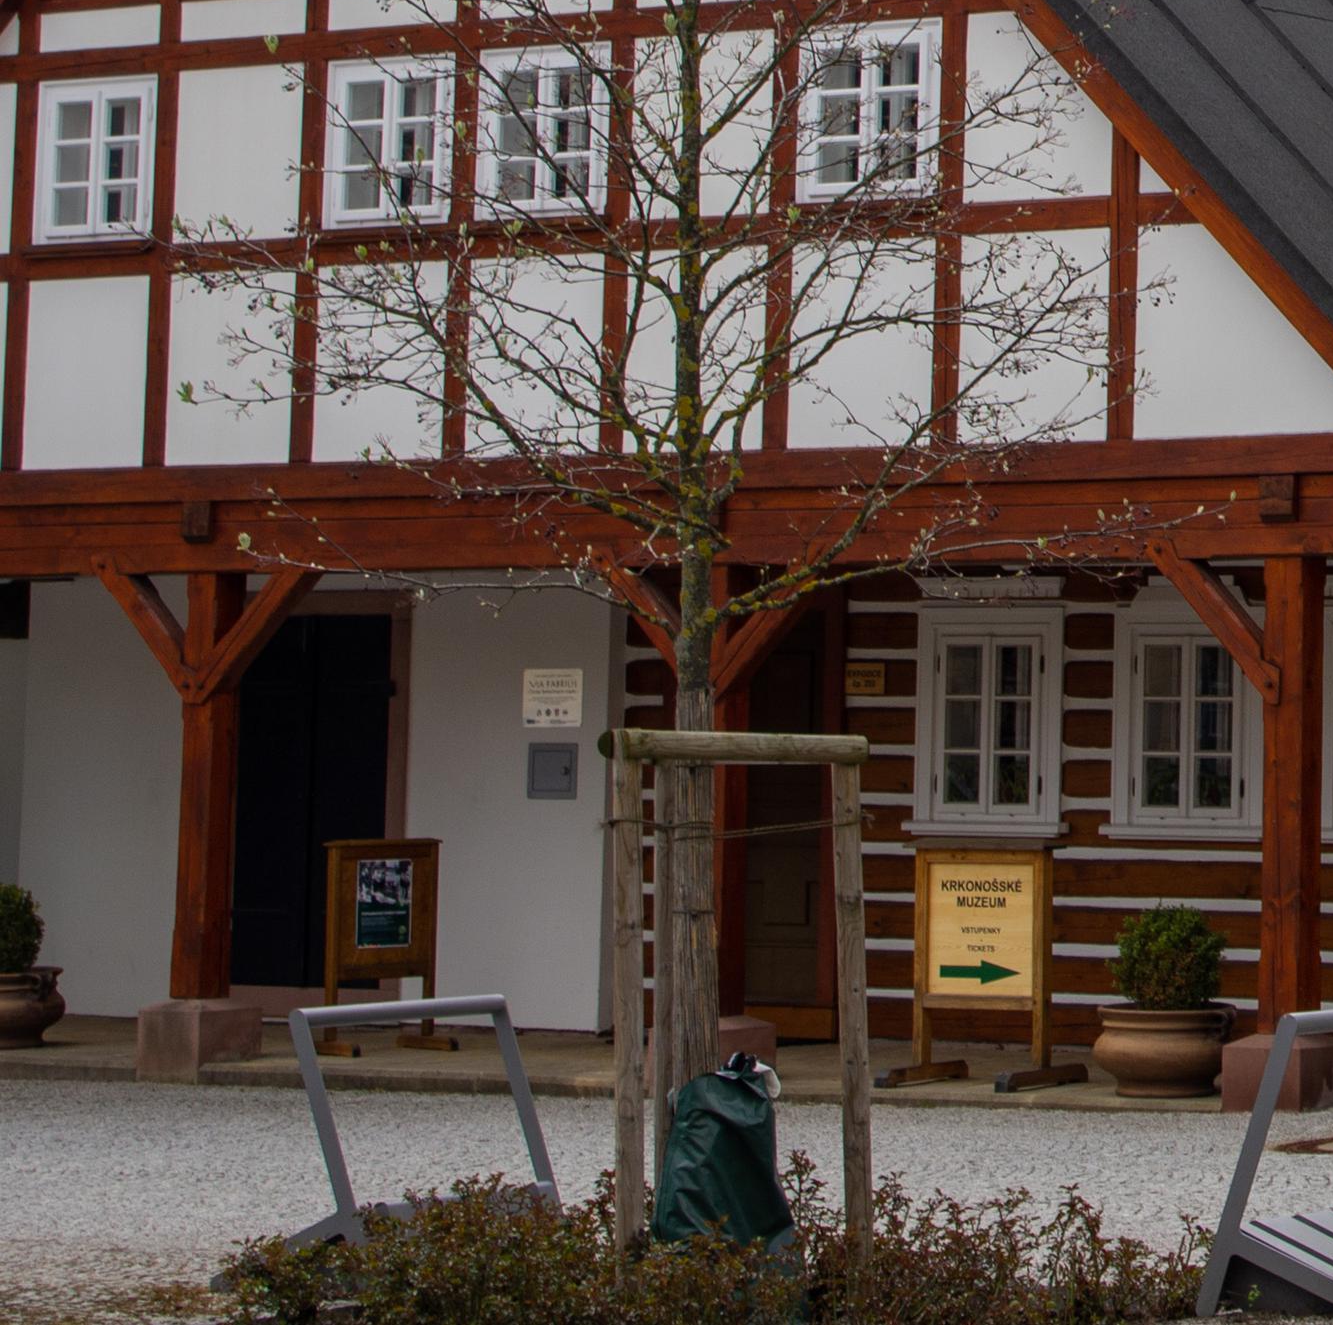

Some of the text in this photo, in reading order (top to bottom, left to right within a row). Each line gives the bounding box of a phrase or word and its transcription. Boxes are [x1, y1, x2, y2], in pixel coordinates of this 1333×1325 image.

[941, 878, 1022, 893] KRKONOŠSKÉ
[957, 896, 1006, 908] MUZEUM
[961, 926, 1001, 935] VSTUPENKY
